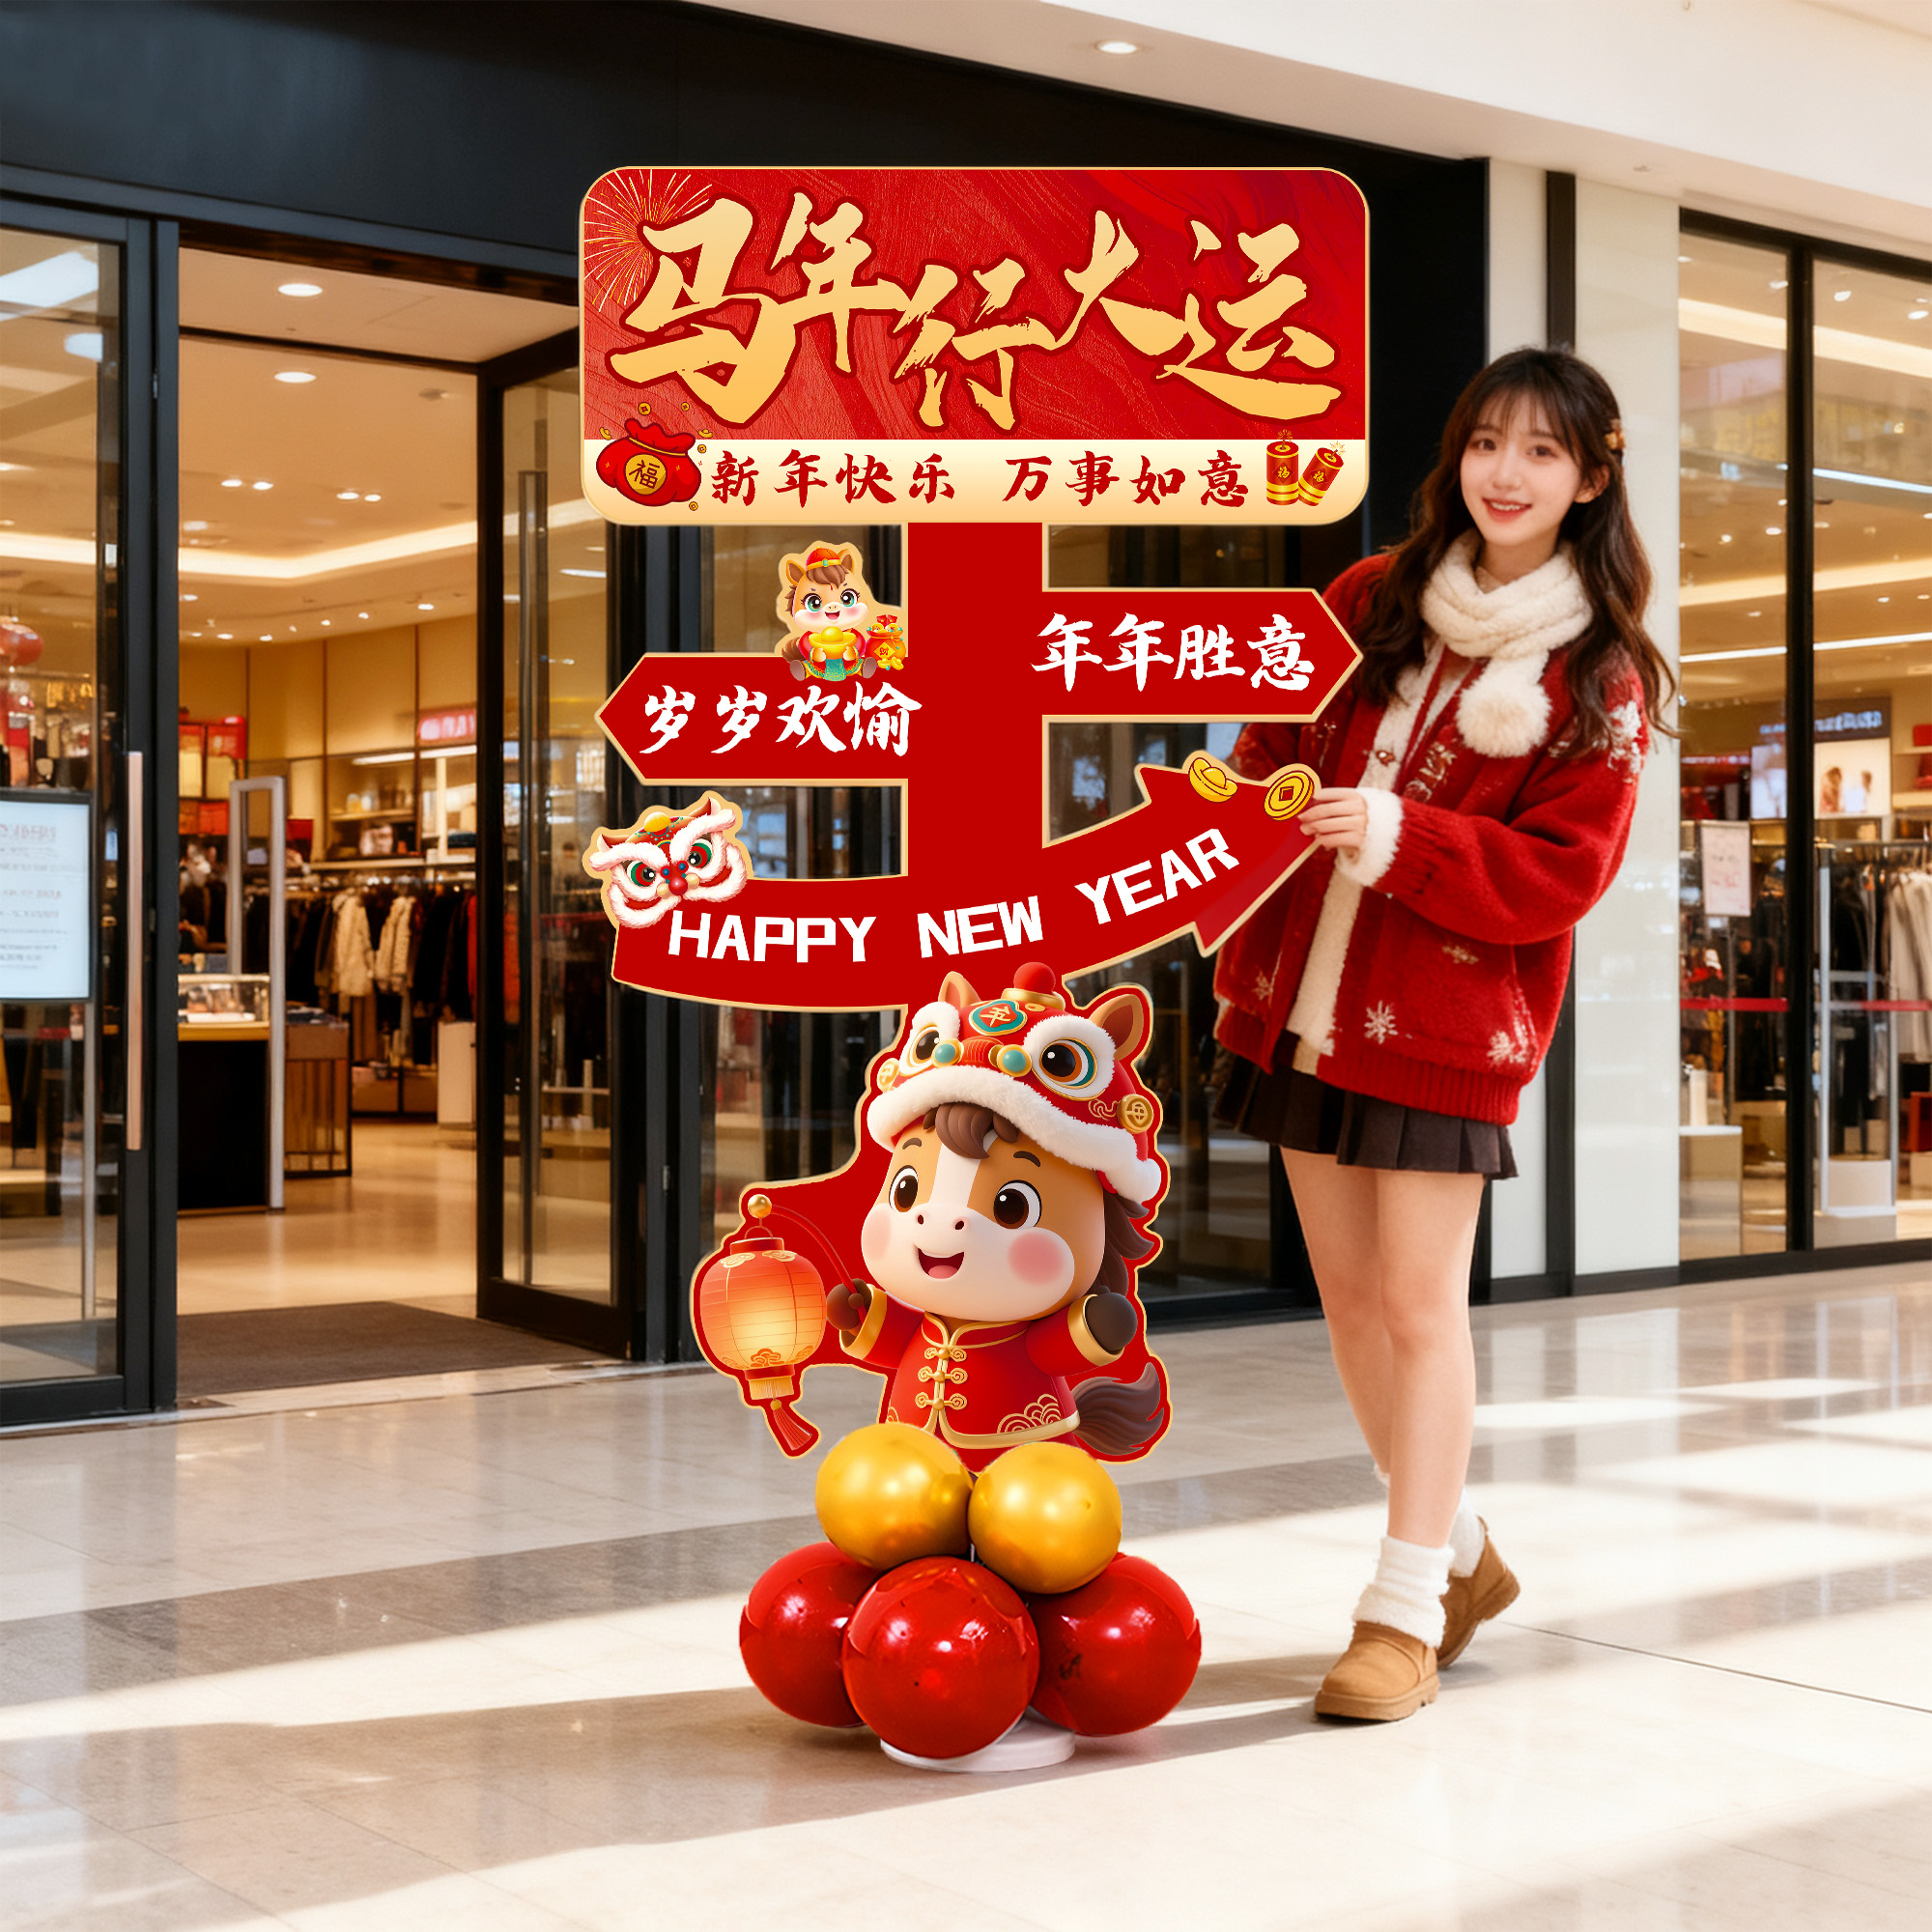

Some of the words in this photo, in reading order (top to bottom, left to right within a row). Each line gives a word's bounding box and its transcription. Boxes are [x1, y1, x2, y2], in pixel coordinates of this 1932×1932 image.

[611, 193, 1341, 430] 马年行大运
[629, 460, 660, 489] 福
[711, 449, 954, 508] 新年快乐
[1003, 450, 1248, 507] 万事如意
[1032, 612, 1314, 692] 年年胜意
[639, 682, 922, 756] 岁岁欢愉
[668, 910, 876, 962] HAPPY
[918, 895, 1042, 957] NEW
[1075, 828, 1239, 925] YEAR
